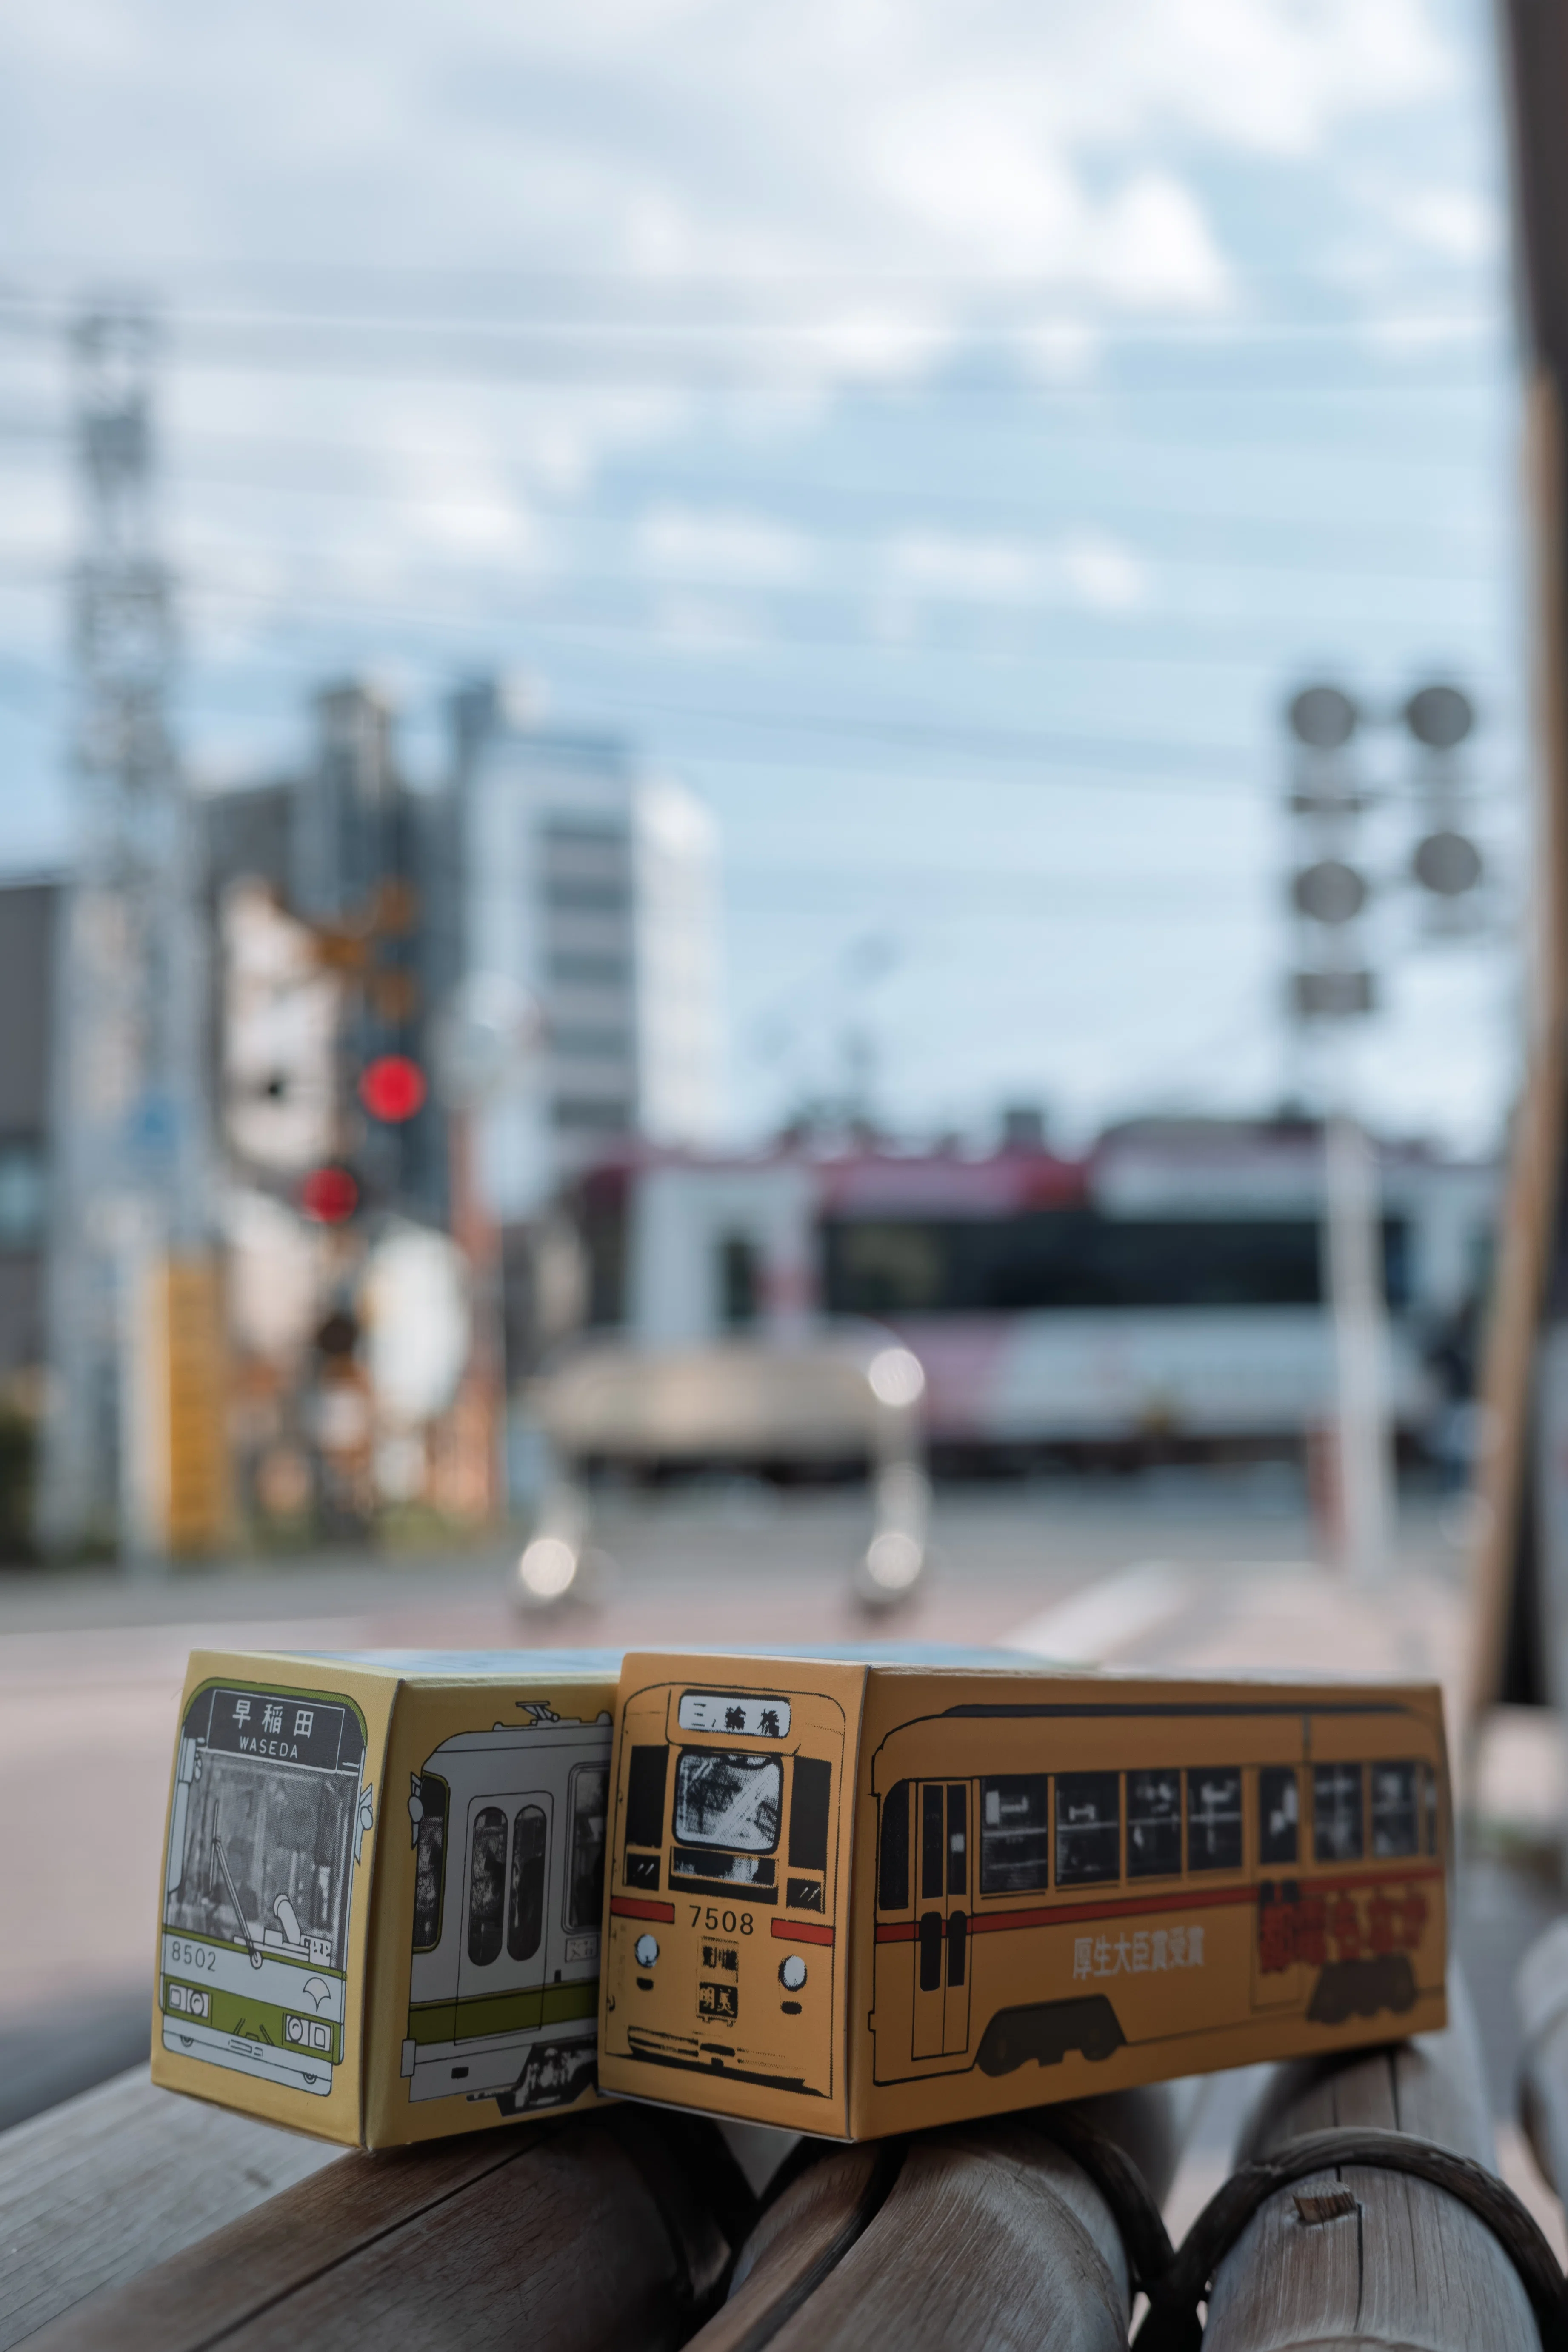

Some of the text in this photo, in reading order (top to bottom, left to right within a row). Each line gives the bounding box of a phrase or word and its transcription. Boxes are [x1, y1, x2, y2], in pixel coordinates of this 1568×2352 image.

[232, 1699, 314, 1738] 早稲田
[240, 1735, 298, 1758] WASEDA
[689, 1904, 754, 1935] 7508
[172, 1941, 216, 1972] 8502
